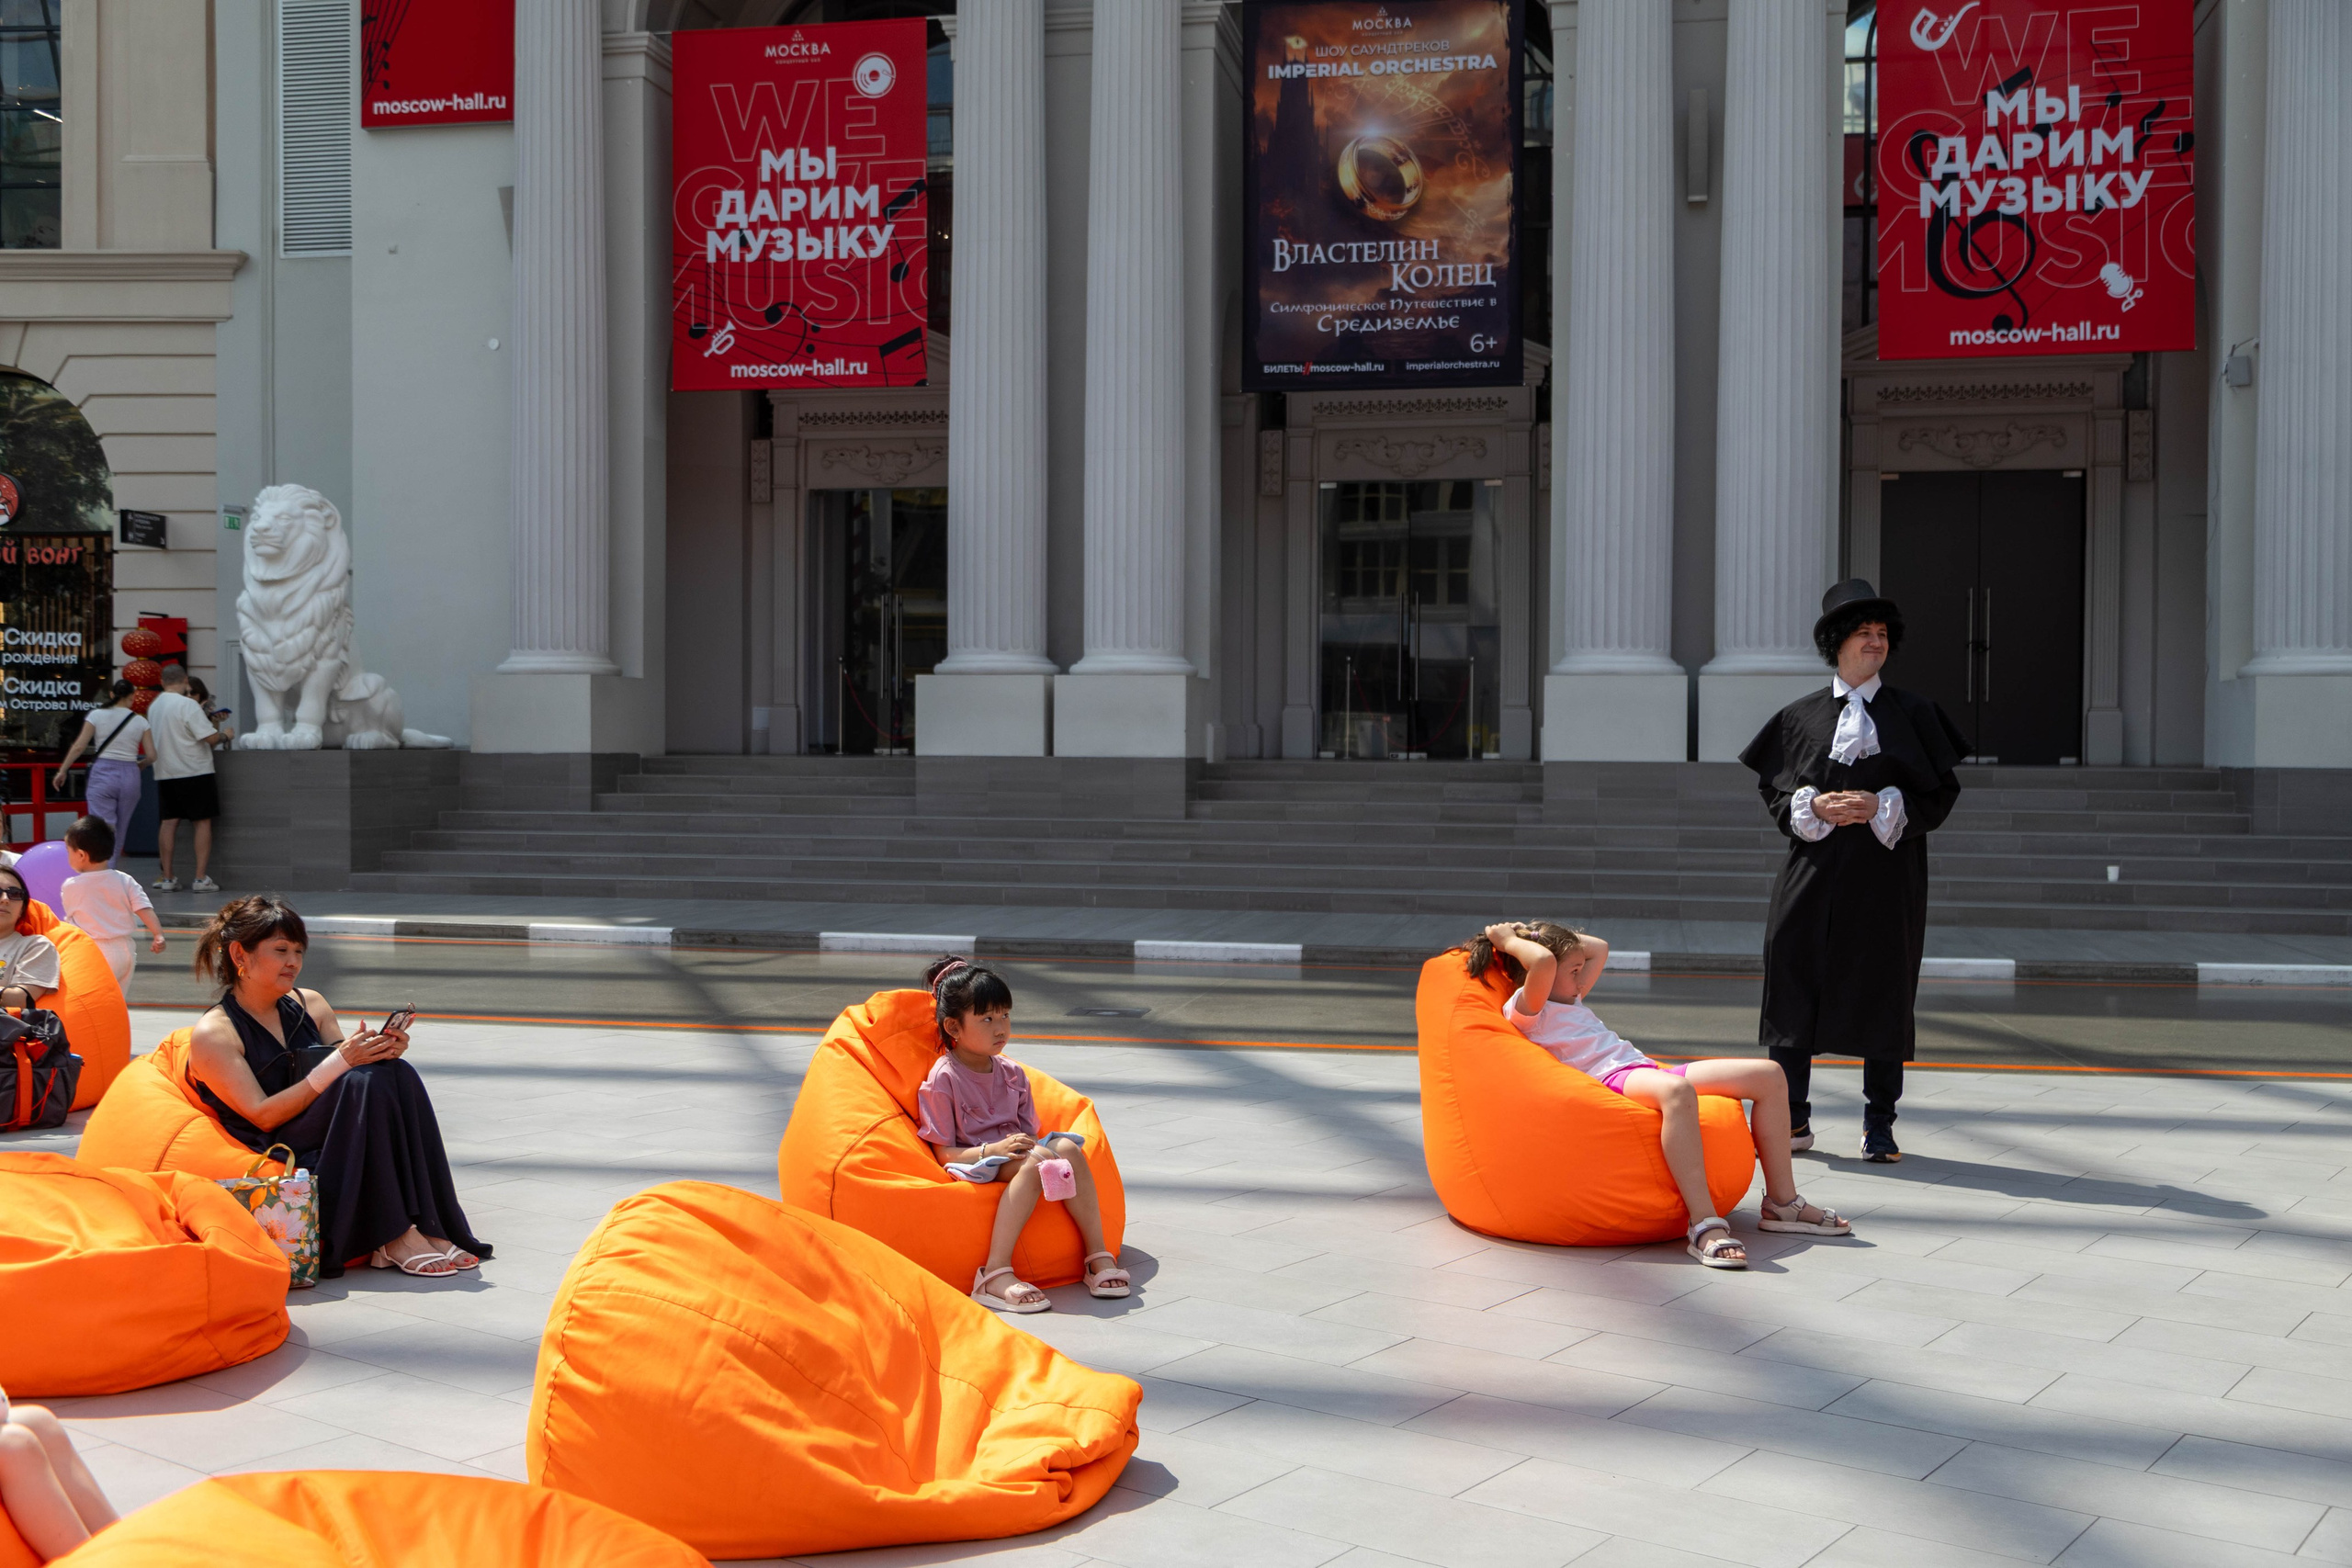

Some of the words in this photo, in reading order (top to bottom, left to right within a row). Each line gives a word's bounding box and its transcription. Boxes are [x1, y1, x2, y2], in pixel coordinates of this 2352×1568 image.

[1352, 17, 1412, 30] МОСКВА
[765, 42, 831, 58] МОСКВА
[1316, 45, 1346, 57] ШОУ
[1351, 40, 1450, 56] САУНДТРЕКОВ
[1268, 62, 1363, 79] IMPERIAL
[1370, 54, 1498, 75] ORCHESTRA
[373, 92, 506, 115] moscow-hall.ru
[1987, 85, 2080, 127] МЫ
[761, 146, 836, 182] МЫ
[1931, 126, 2134, 180] ДАРИМ
[1919, 170, 2154, 219] МУЗЫКУ
[717, 185, 879, 229] ДАРИМ
[707, 224, 896, 263] МУЗЫКУ
[1270, 301, 1386, 315] Симфоническое
[1389, 299, 1485, 312] Путешествие
[1317, 314, 1460, 337] Средиземье
[1950, 321, 2120, 345] moscow-hall.ru
[1470, 333, 1498, 353] 6+
[730, 358, 867, 378] moscow-hall.ru
[1407, 360, 1499, 371] imperialorchestra.ru
[4, 627, 82, 649] Скидка
[2, 652, 78, 666] рождения
[3, 677, 81, 698] Скидка
[11, 699, 67, 712] Острова
